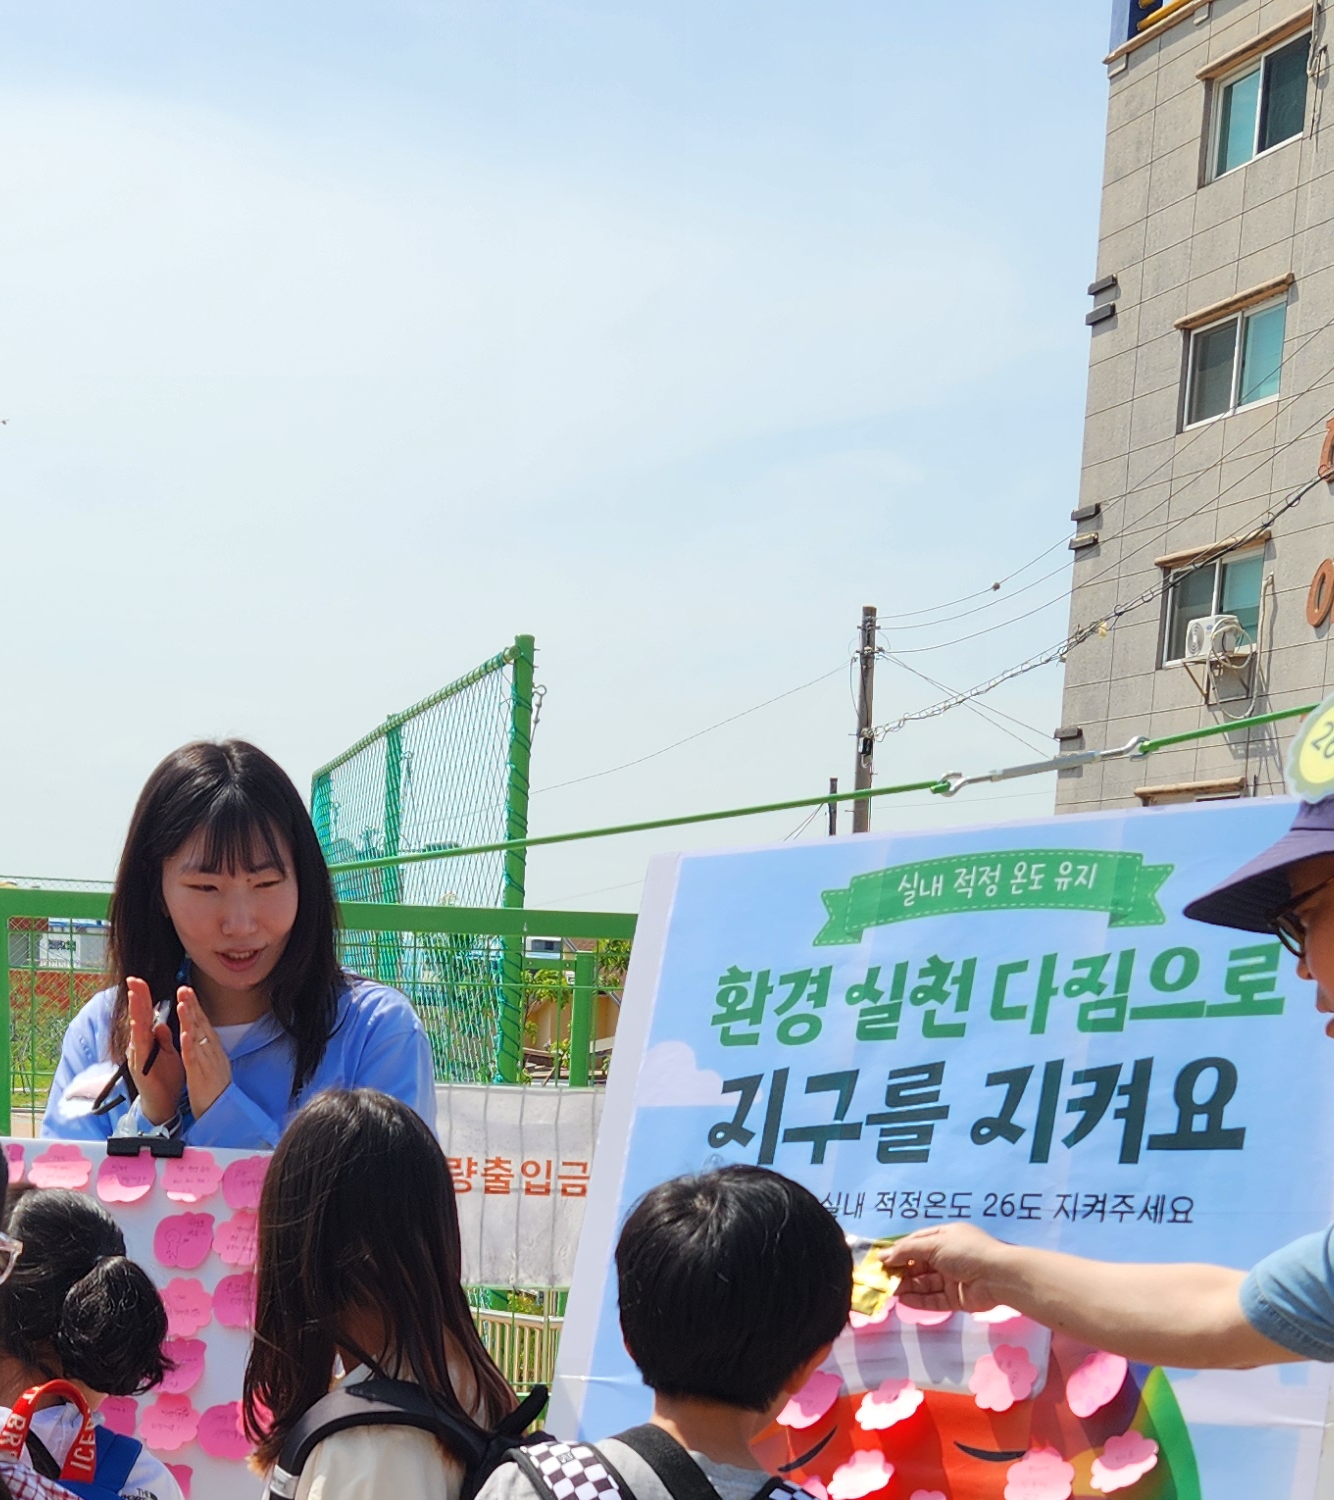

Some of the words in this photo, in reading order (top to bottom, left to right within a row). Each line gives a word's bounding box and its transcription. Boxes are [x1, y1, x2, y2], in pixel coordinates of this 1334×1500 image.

[896, 870, 946, 908] 실내
[952, 864, 1002, 900] 적정
[1007, 860, 1048, 898] 온도
[1053, 859, 1098, 893] 유지
[709, 963, 835, 1048] 환경
[845, 954, 978, 1042] 실천
[988, 943, 1286, 1036] 다짐으로
[707, 1060, 950, 1166] 지구를
[969, 1055, 1246, 1166] 지켜요
[817, 1191, 867, 1221] 실내
[873, 1191, 973, 1221] 적정온도
[982, 1191, 1043, 1222] 26도
[1052, 1191, 1195, 1226] 지켜주세요
